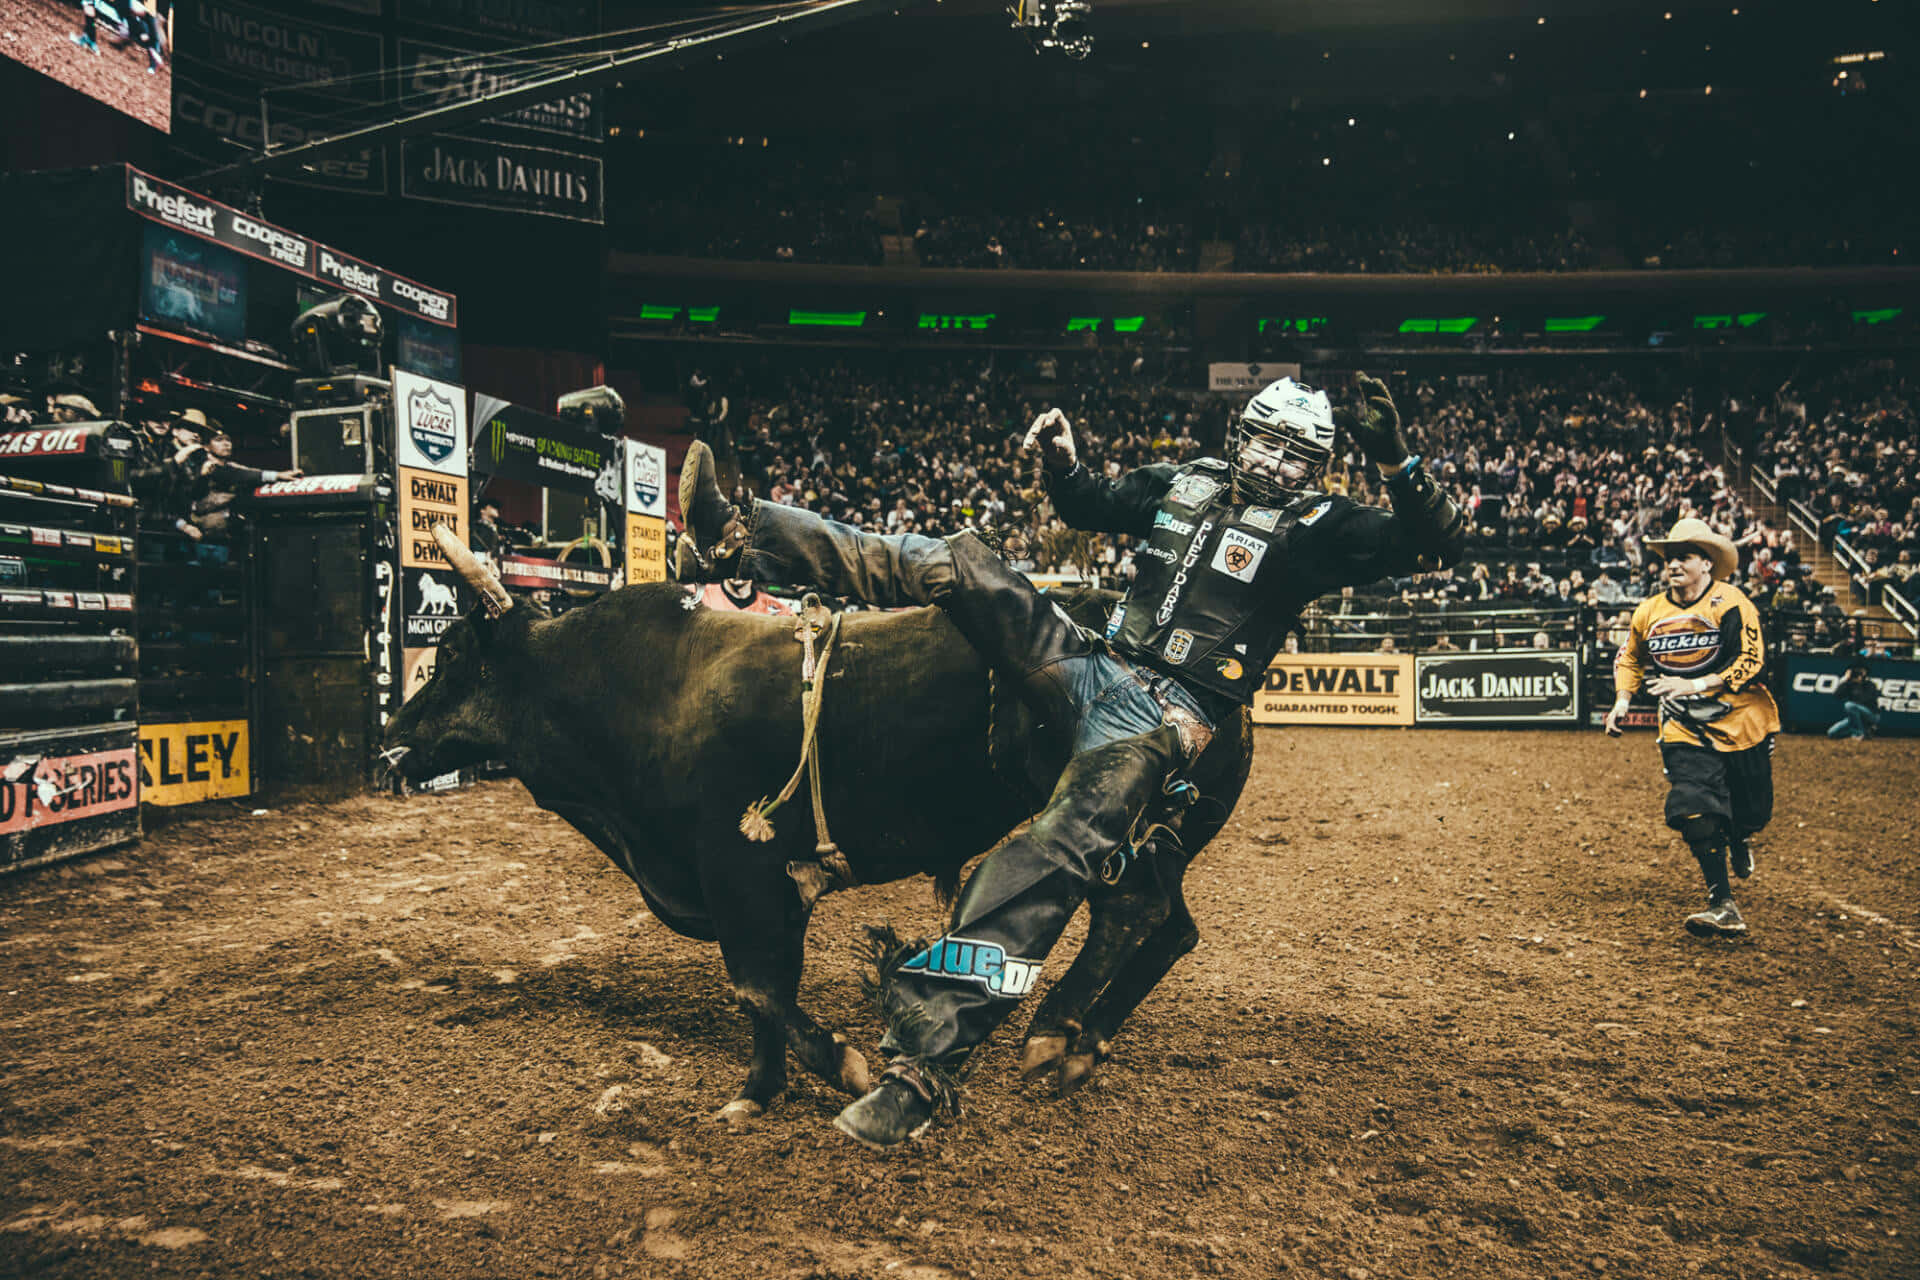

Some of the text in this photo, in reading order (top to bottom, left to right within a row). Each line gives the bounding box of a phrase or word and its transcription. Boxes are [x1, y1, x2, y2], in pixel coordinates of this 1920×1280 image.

[199, 3, 319, 57] LINCOLN
[423, 146, 489, 188] JACK
[231, 214, 307, 257] COOPER
[269, 244, 305, 268] TIRES
[392, 279, 449, 310] COOPER
[416, 411, 453, 433] LUCAS
[42, 429, 81, 452] OIL
[573, 447, 601, 469] BATTLE
[1226, 532, 1265, 552] ARIAT
[1157, 520, 1213, 621] PNEU-DART
[408, 619, 434, 634] MGM
[1648, 633, 1720, 651] Dickies
[1421, 673, 1476, 699] JACK
[1264, 703, 1348, 713] GUARANTEED
